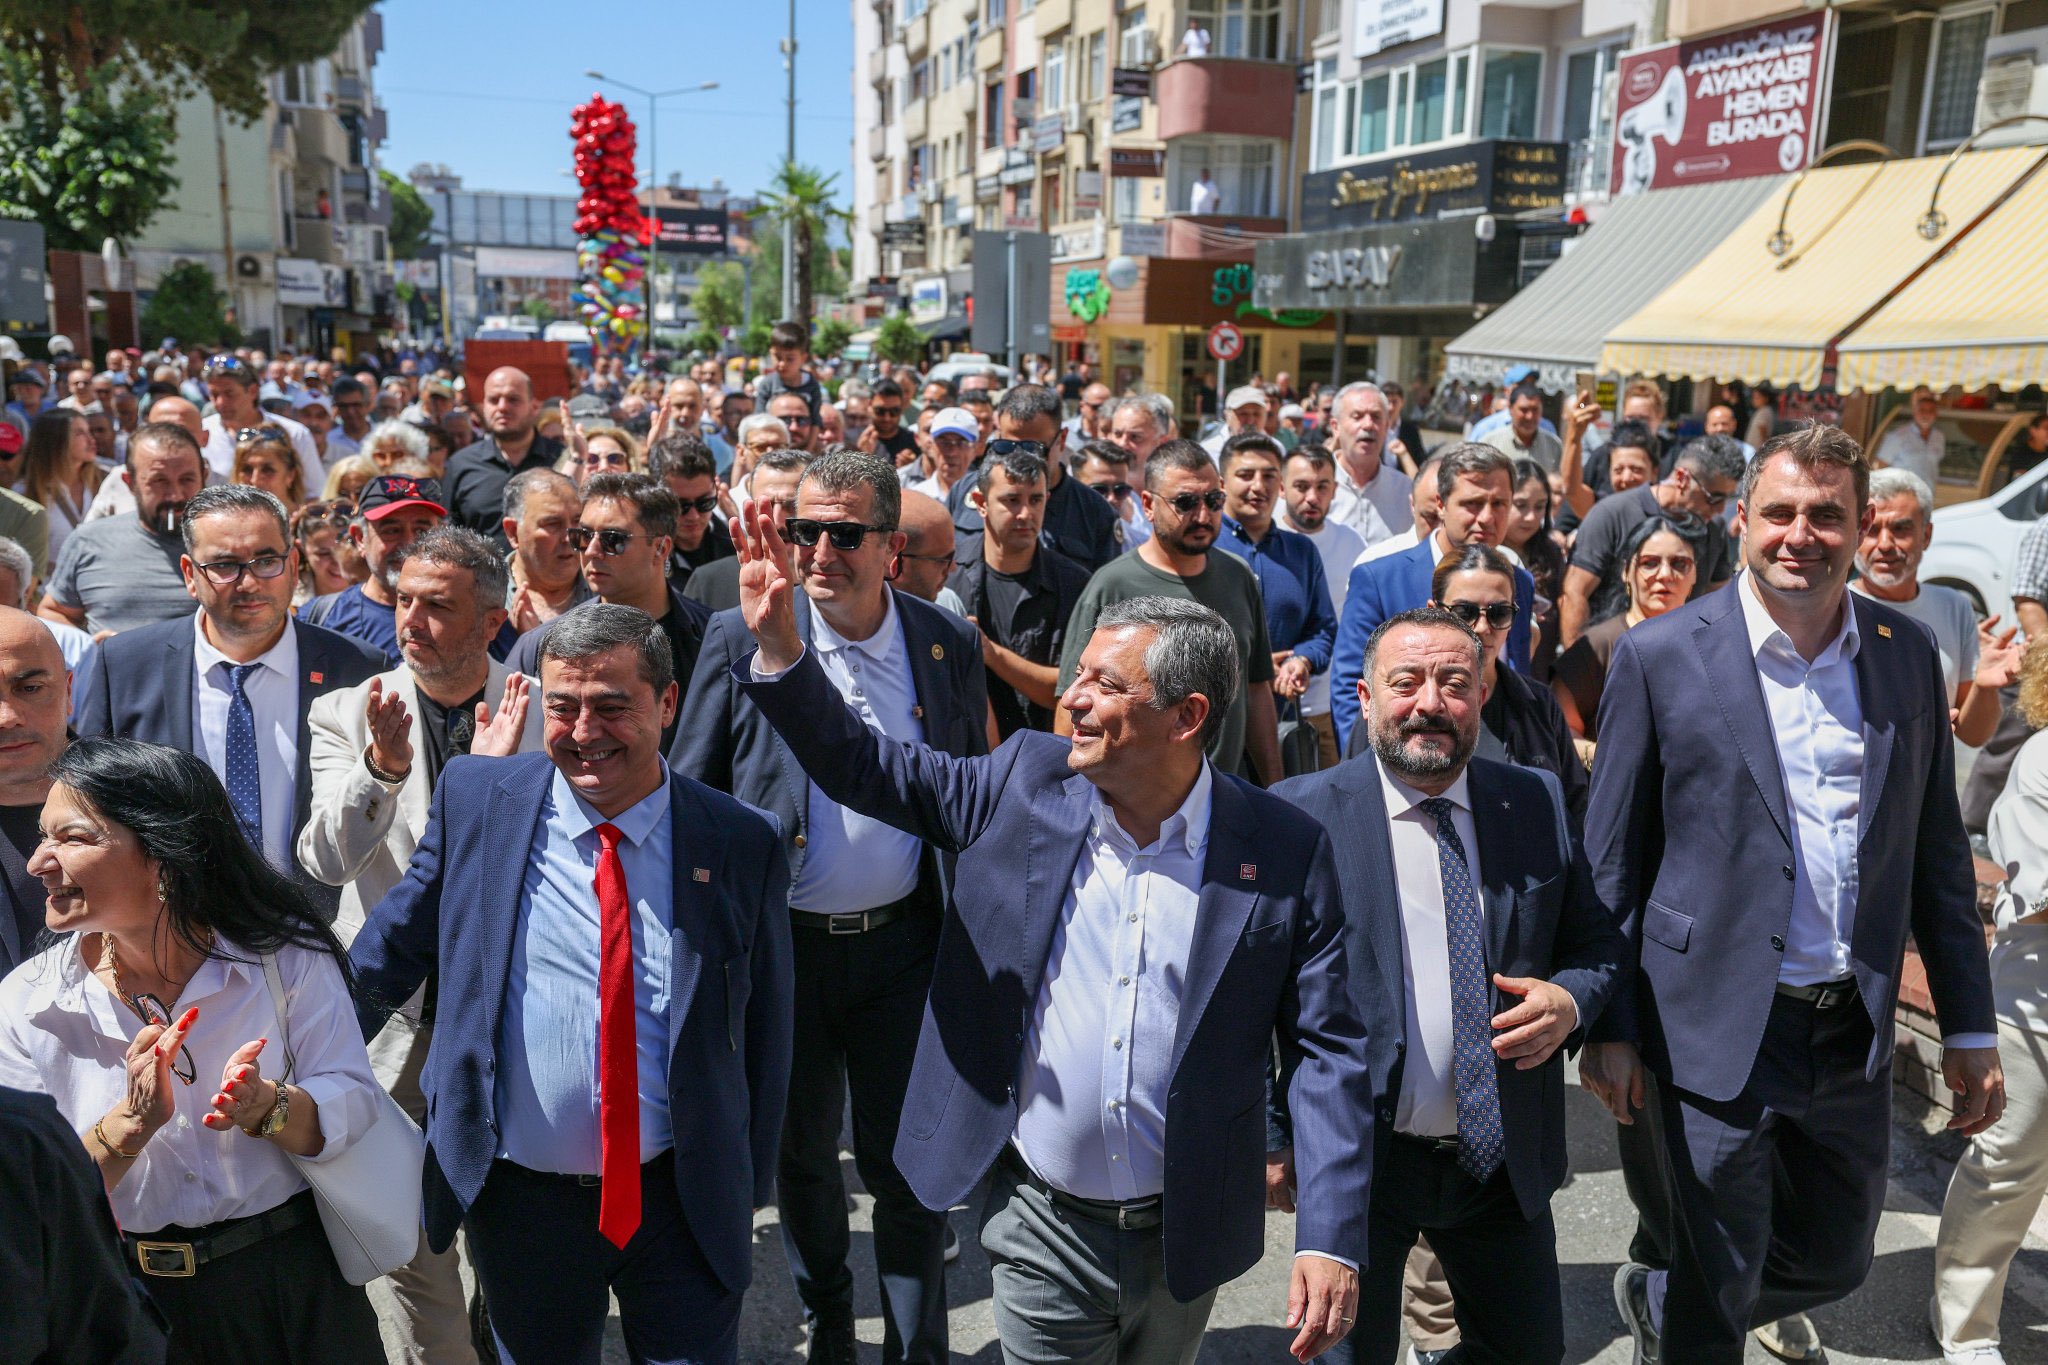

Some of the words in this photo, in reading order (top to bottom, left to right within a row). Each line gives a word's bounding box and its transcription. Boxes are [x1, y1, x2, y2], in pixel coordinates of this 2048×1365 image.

[1695, 53, 1812, 99] AYAKKABI
[1723, 81, 1809, 118] HEMEN
[1706, 108, 1806, 146] BURADA
[1306, 244, 1402, 289] SARAY
